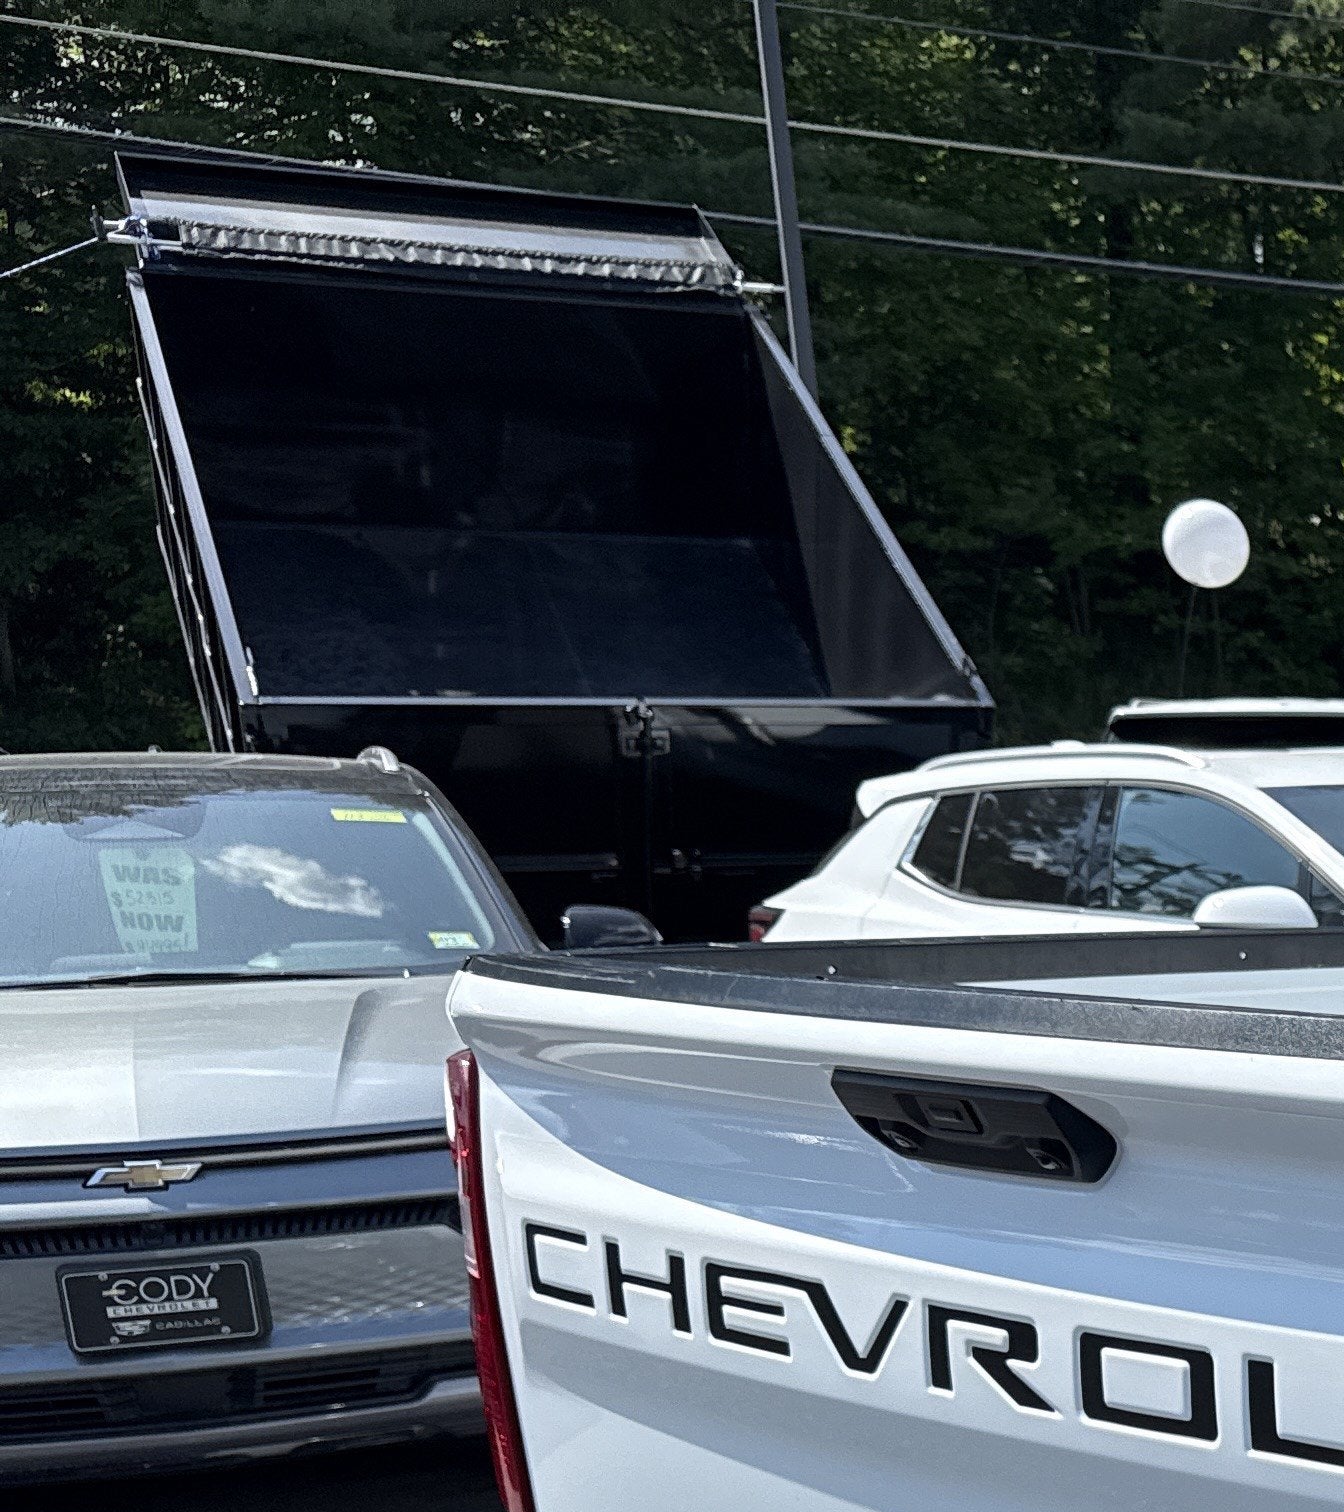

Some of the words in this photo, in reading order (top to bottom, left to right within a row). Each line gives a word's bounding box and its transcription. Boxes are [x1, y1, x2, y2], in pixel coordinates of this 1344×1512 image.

[111, 864, 181, 886] WAS
[120, 911, 185, 933] NOW
[111, 1272, 214, 1305] CODY
[112, 1299, 212, 1316] CHEVROLET
